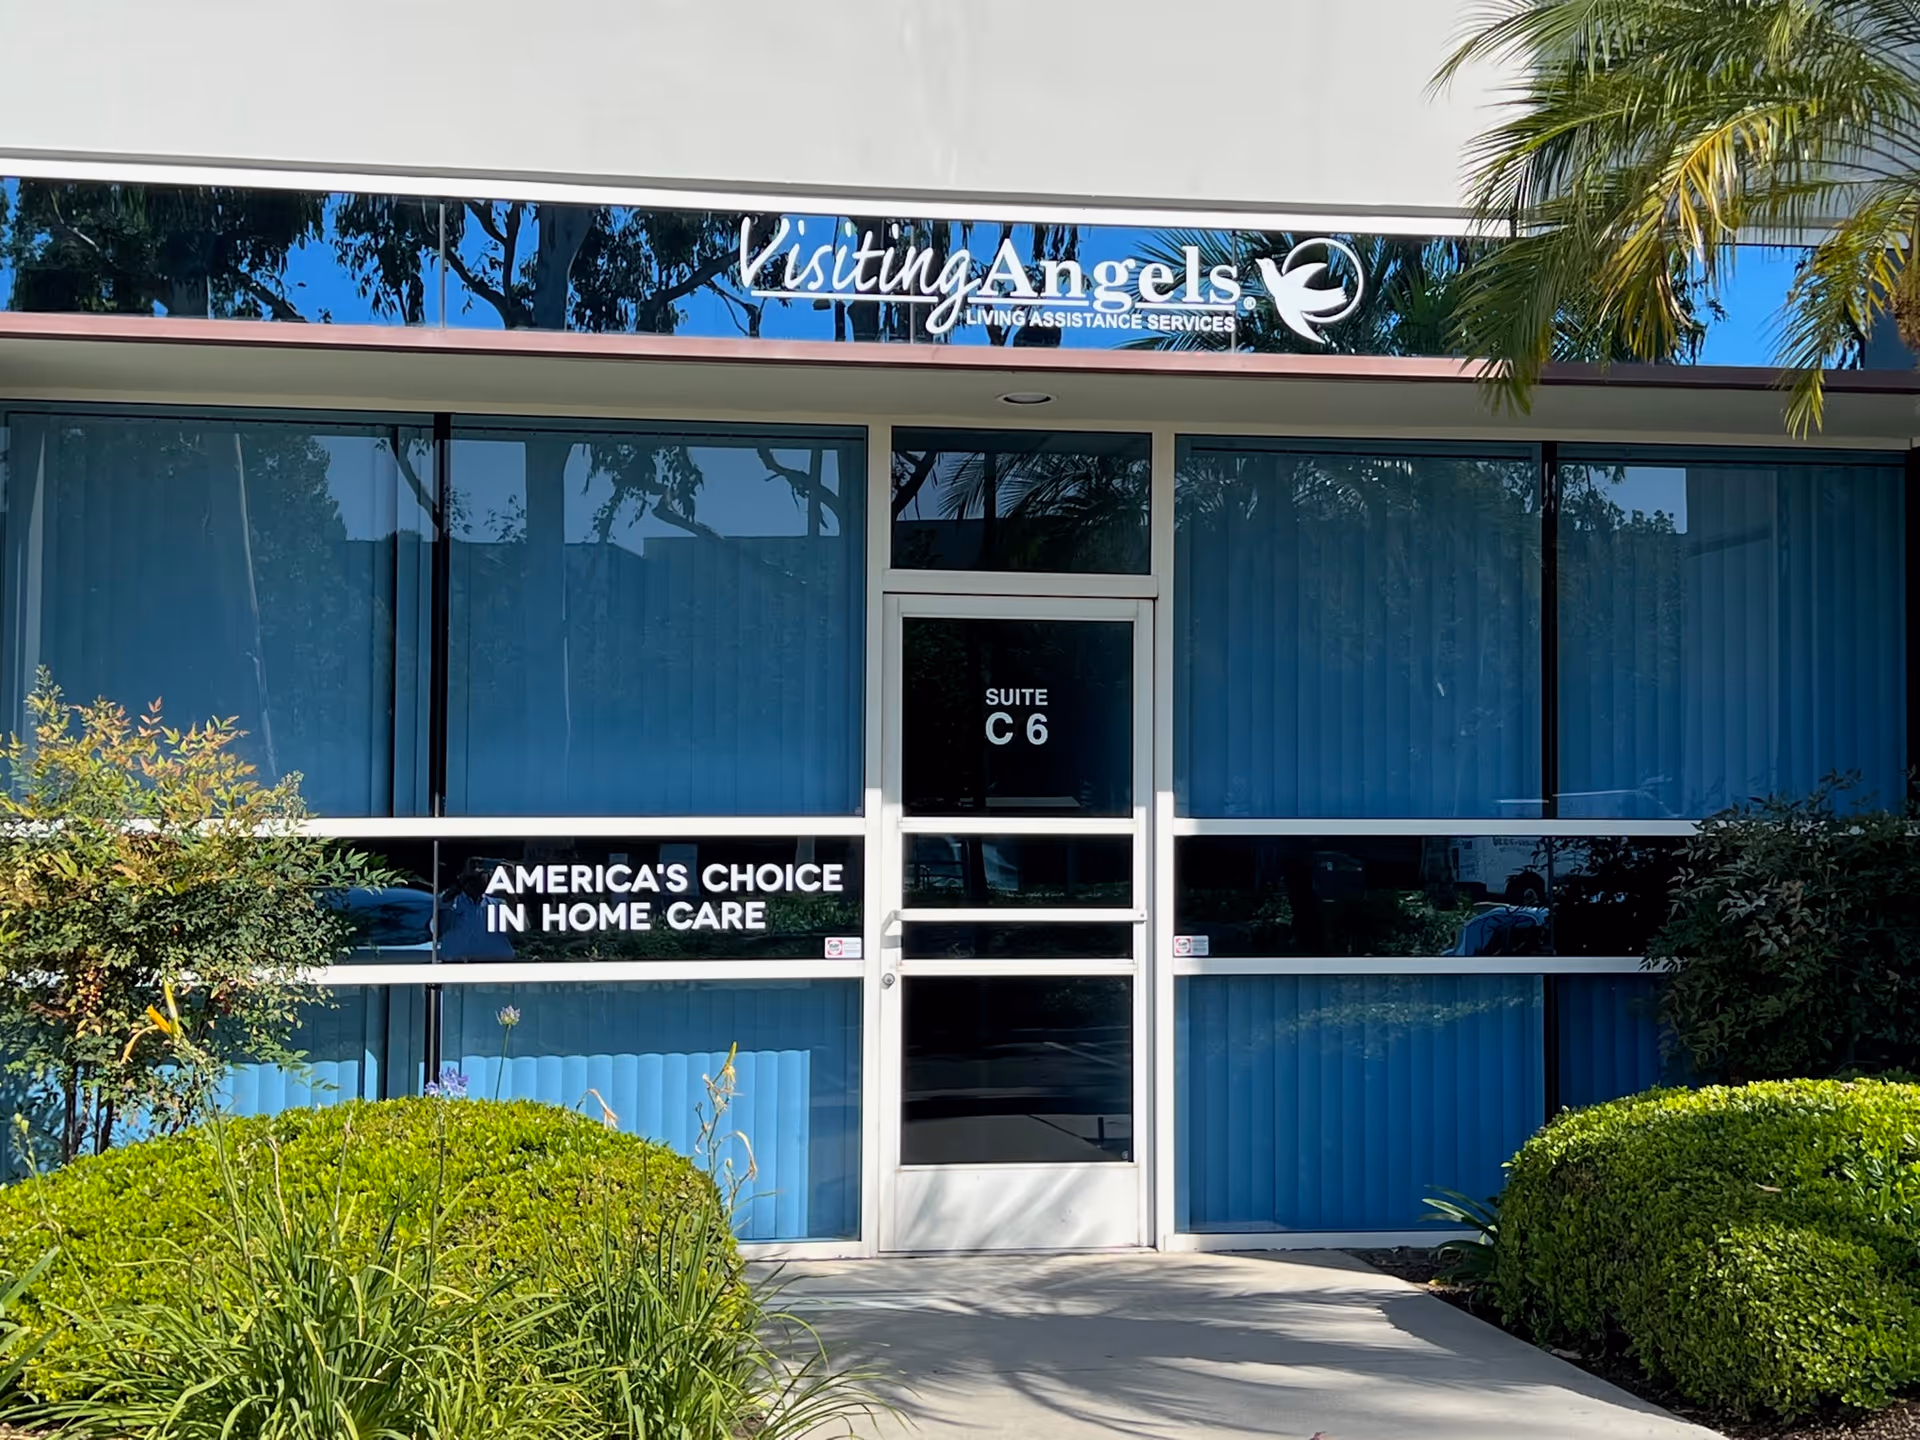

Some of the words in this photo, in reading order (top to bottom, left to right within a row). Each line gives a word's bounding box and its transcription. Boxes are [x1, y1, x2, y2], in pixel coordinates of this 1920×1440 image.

[740, 216, 982, 334] Visiting
[976, 238, 1241, 312] Angels
[966, 310, 1027, 328] LIVING
[1029, 312, 1142, 330] ASSISTANCE
[1147, 313, 1236, 332] SERVICES
[985, 688, 1049, 706] SUITE
[985, 711, 1014, 746] C
[1026, 712, 1049, 746] 6
[485, 863, 688, 894] AMERICA'S
[702, 863, 844, 893] CHOICE
[487, 903, 525, 933] IN
[542, 902, 652, 932] HOME
[666, 901, 767, 930] CARE
